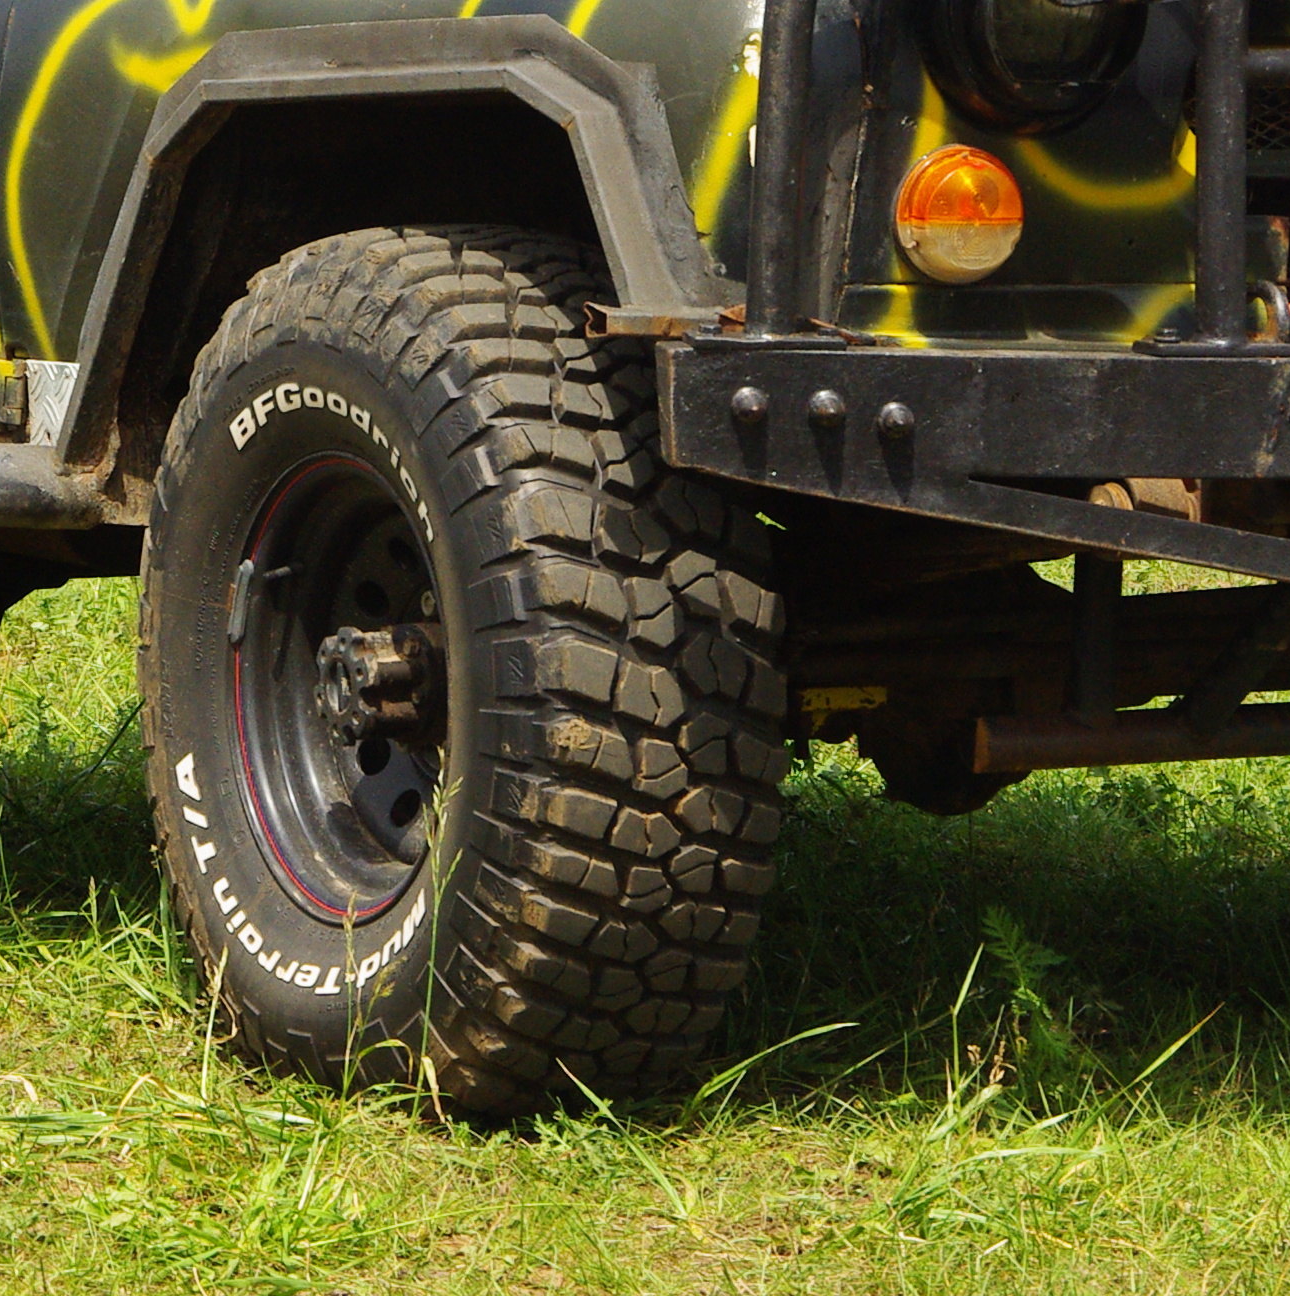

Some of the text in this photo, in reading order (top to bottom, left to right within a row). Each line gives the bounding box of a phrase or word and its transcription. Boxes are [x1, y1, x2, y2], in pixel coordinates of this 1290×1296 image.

[228, 382, 434, 543] BFGoodrich
[175, 752, 427, 996] Mud-Terrain T/A
